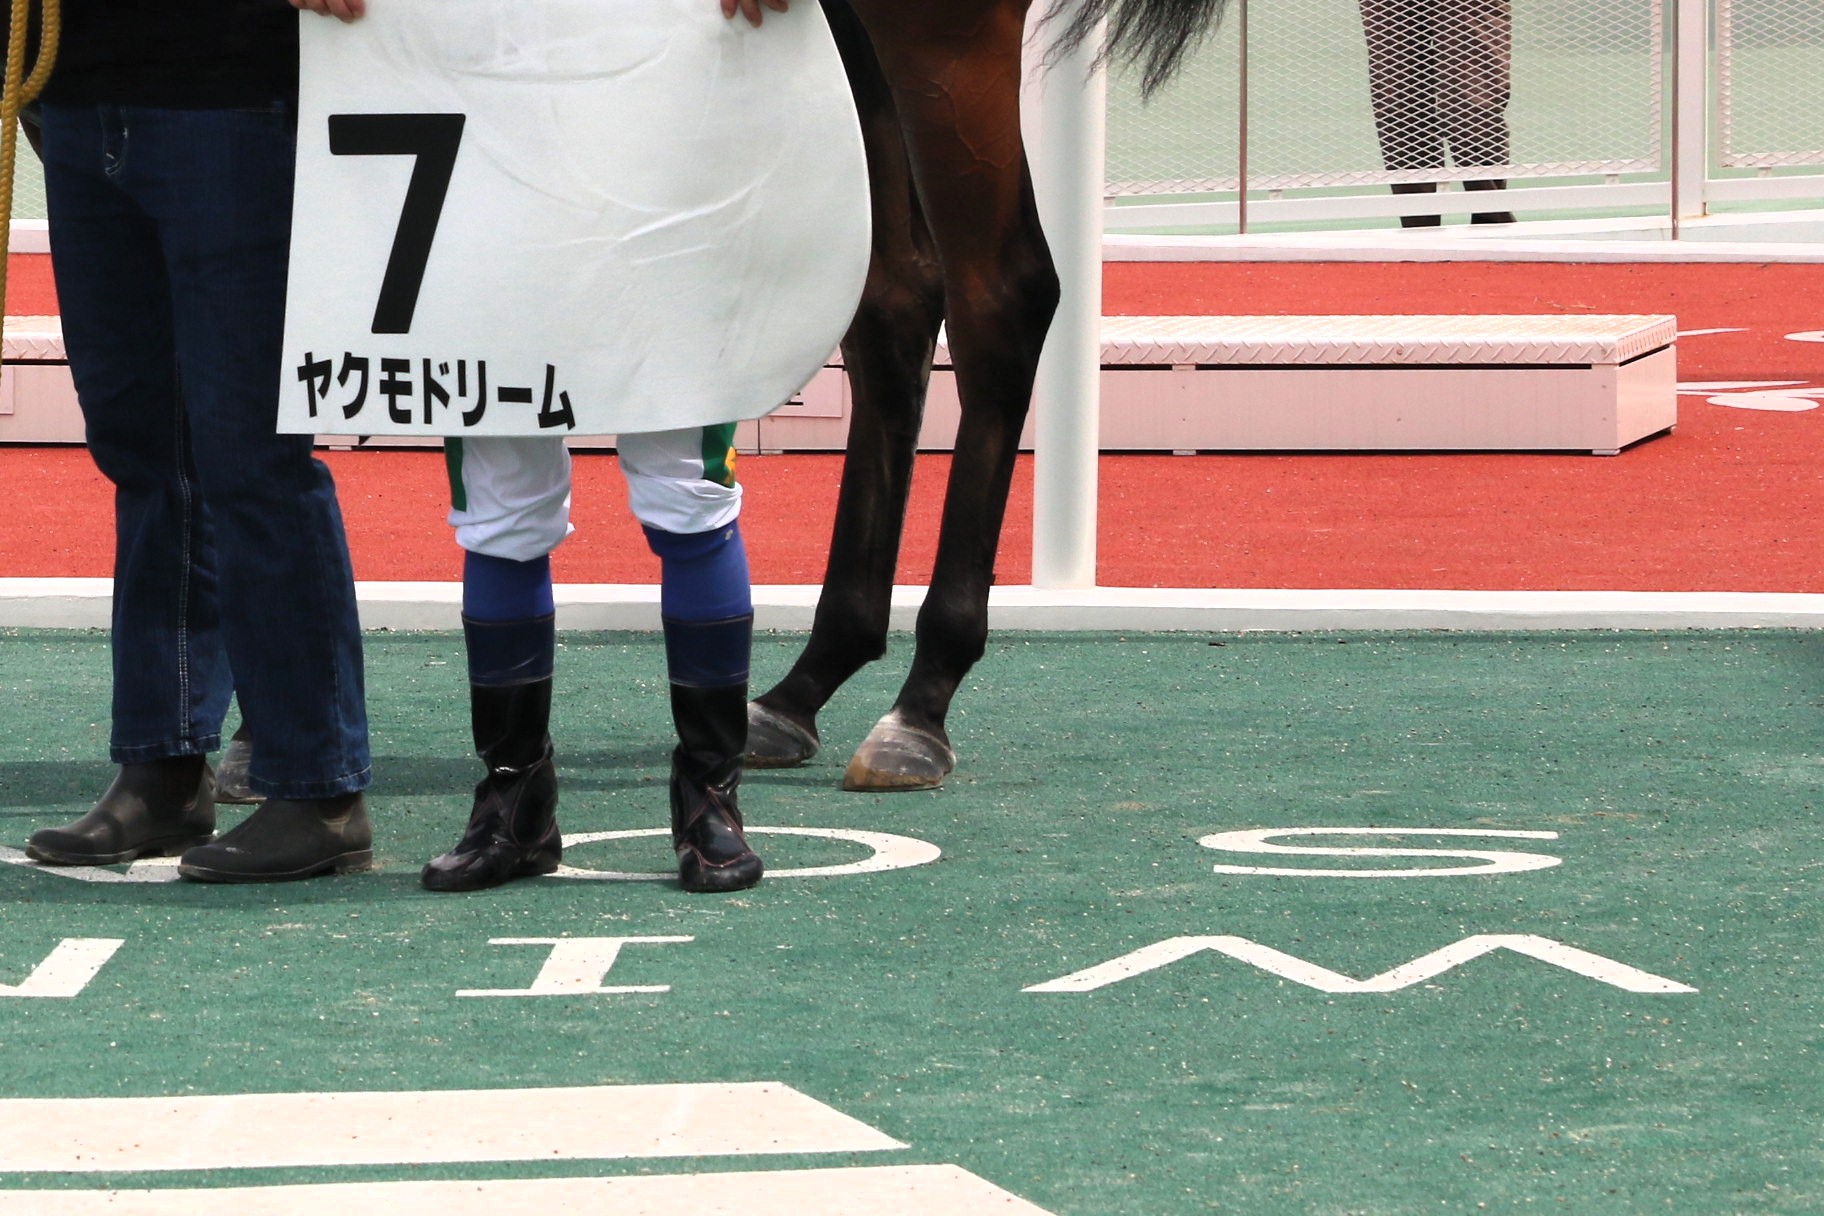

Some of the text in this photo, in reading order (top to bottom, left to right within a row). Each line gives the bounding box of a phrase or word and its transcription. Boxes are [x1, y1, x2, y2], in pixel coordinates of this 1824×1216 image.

[328, 113, 466, 334] 7
[296, 351, 576, 431] ヤクモドリーム
